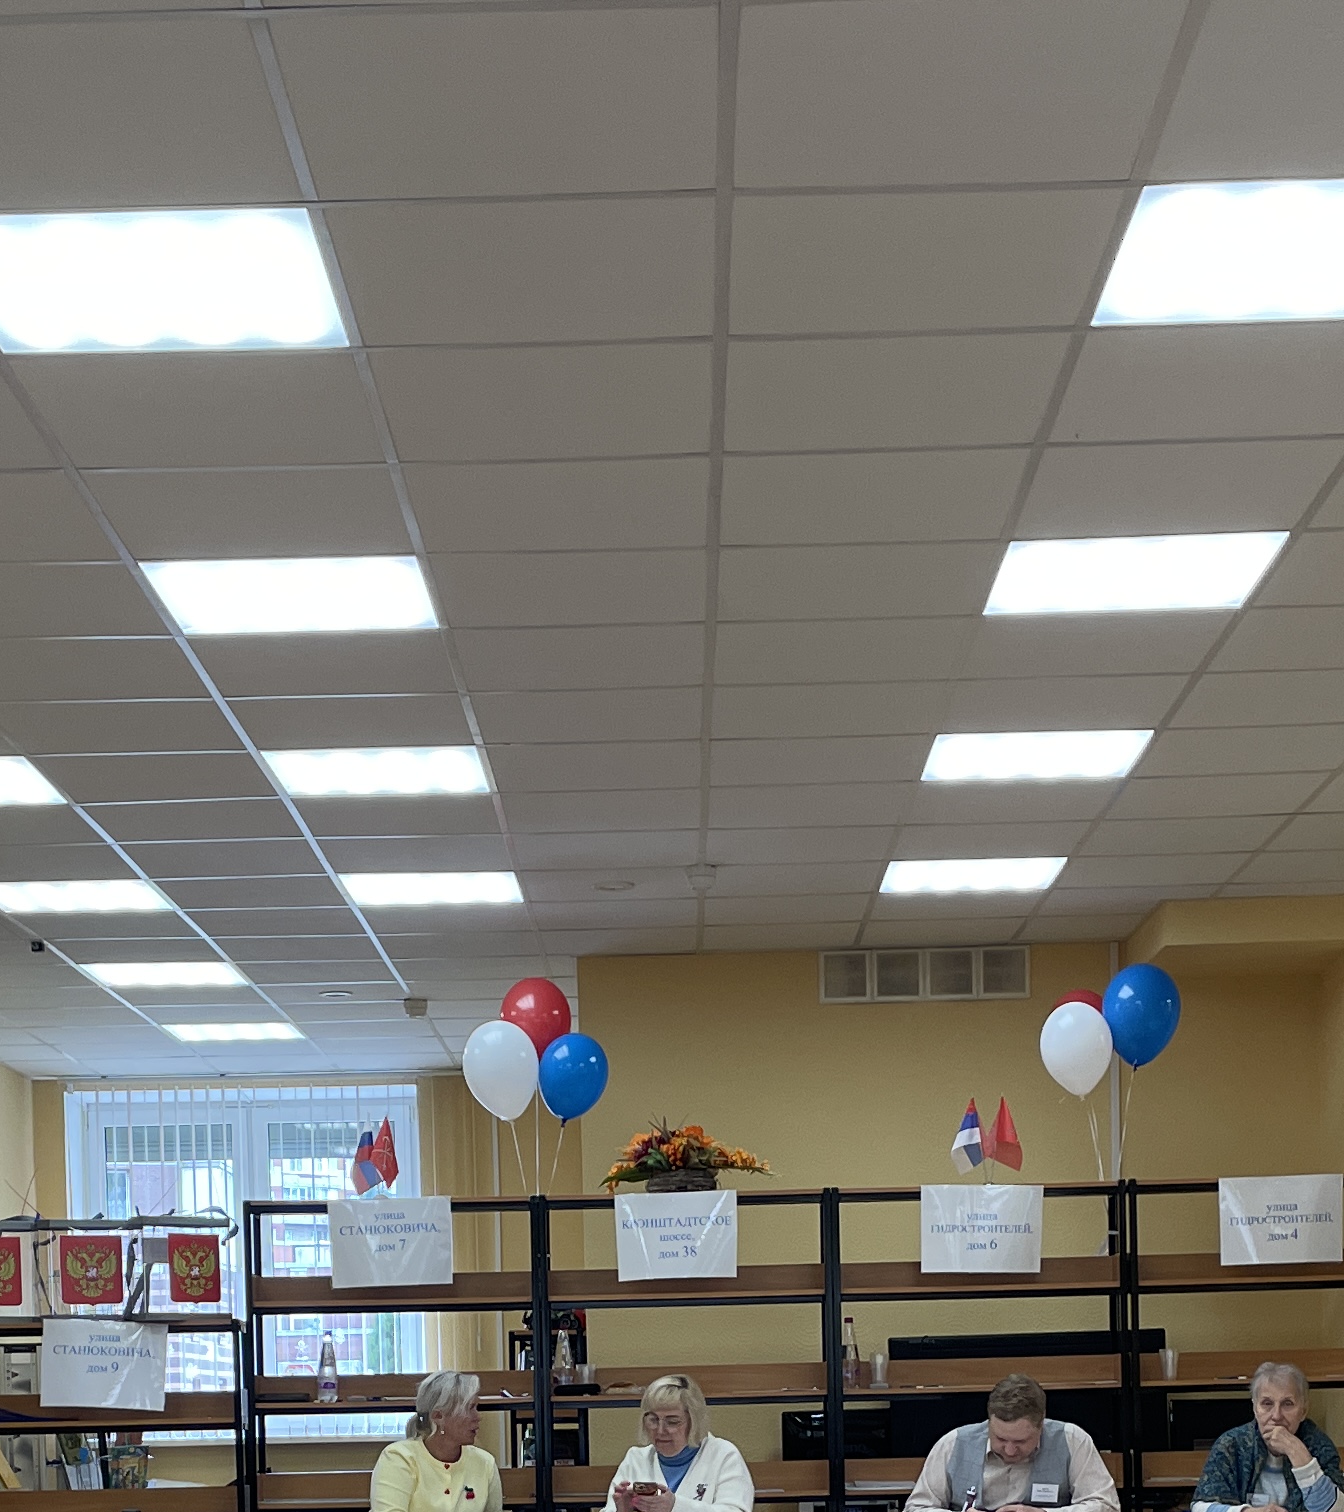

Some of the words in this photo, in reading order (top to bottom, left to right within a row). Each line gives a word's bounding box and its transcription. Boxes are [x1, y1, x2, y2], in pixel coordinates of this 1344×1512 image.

[1266, 1203, 1298, 1214] улица
[374, 1212, 405, 1222] улица
[967, 1213, 998, 1223] улица
[1267, 1232, 1289, 1242] дом
[1290, 1228, 1298, 1240] 4
[374, 1243, 396, 1252] дом
[399, 1239, 406, 1250] 7
[966, 1242, 987, 1251] дом
[989, 1238, 998, 1250] 6
[658, 1250, 679, 1259] дом
[682, 1246, 697, 1258] 38
[88, 1334, 121, 1343] улица
[86, 1364, 108, 1374] дом
[111, 1361, 119, 1373] 9
